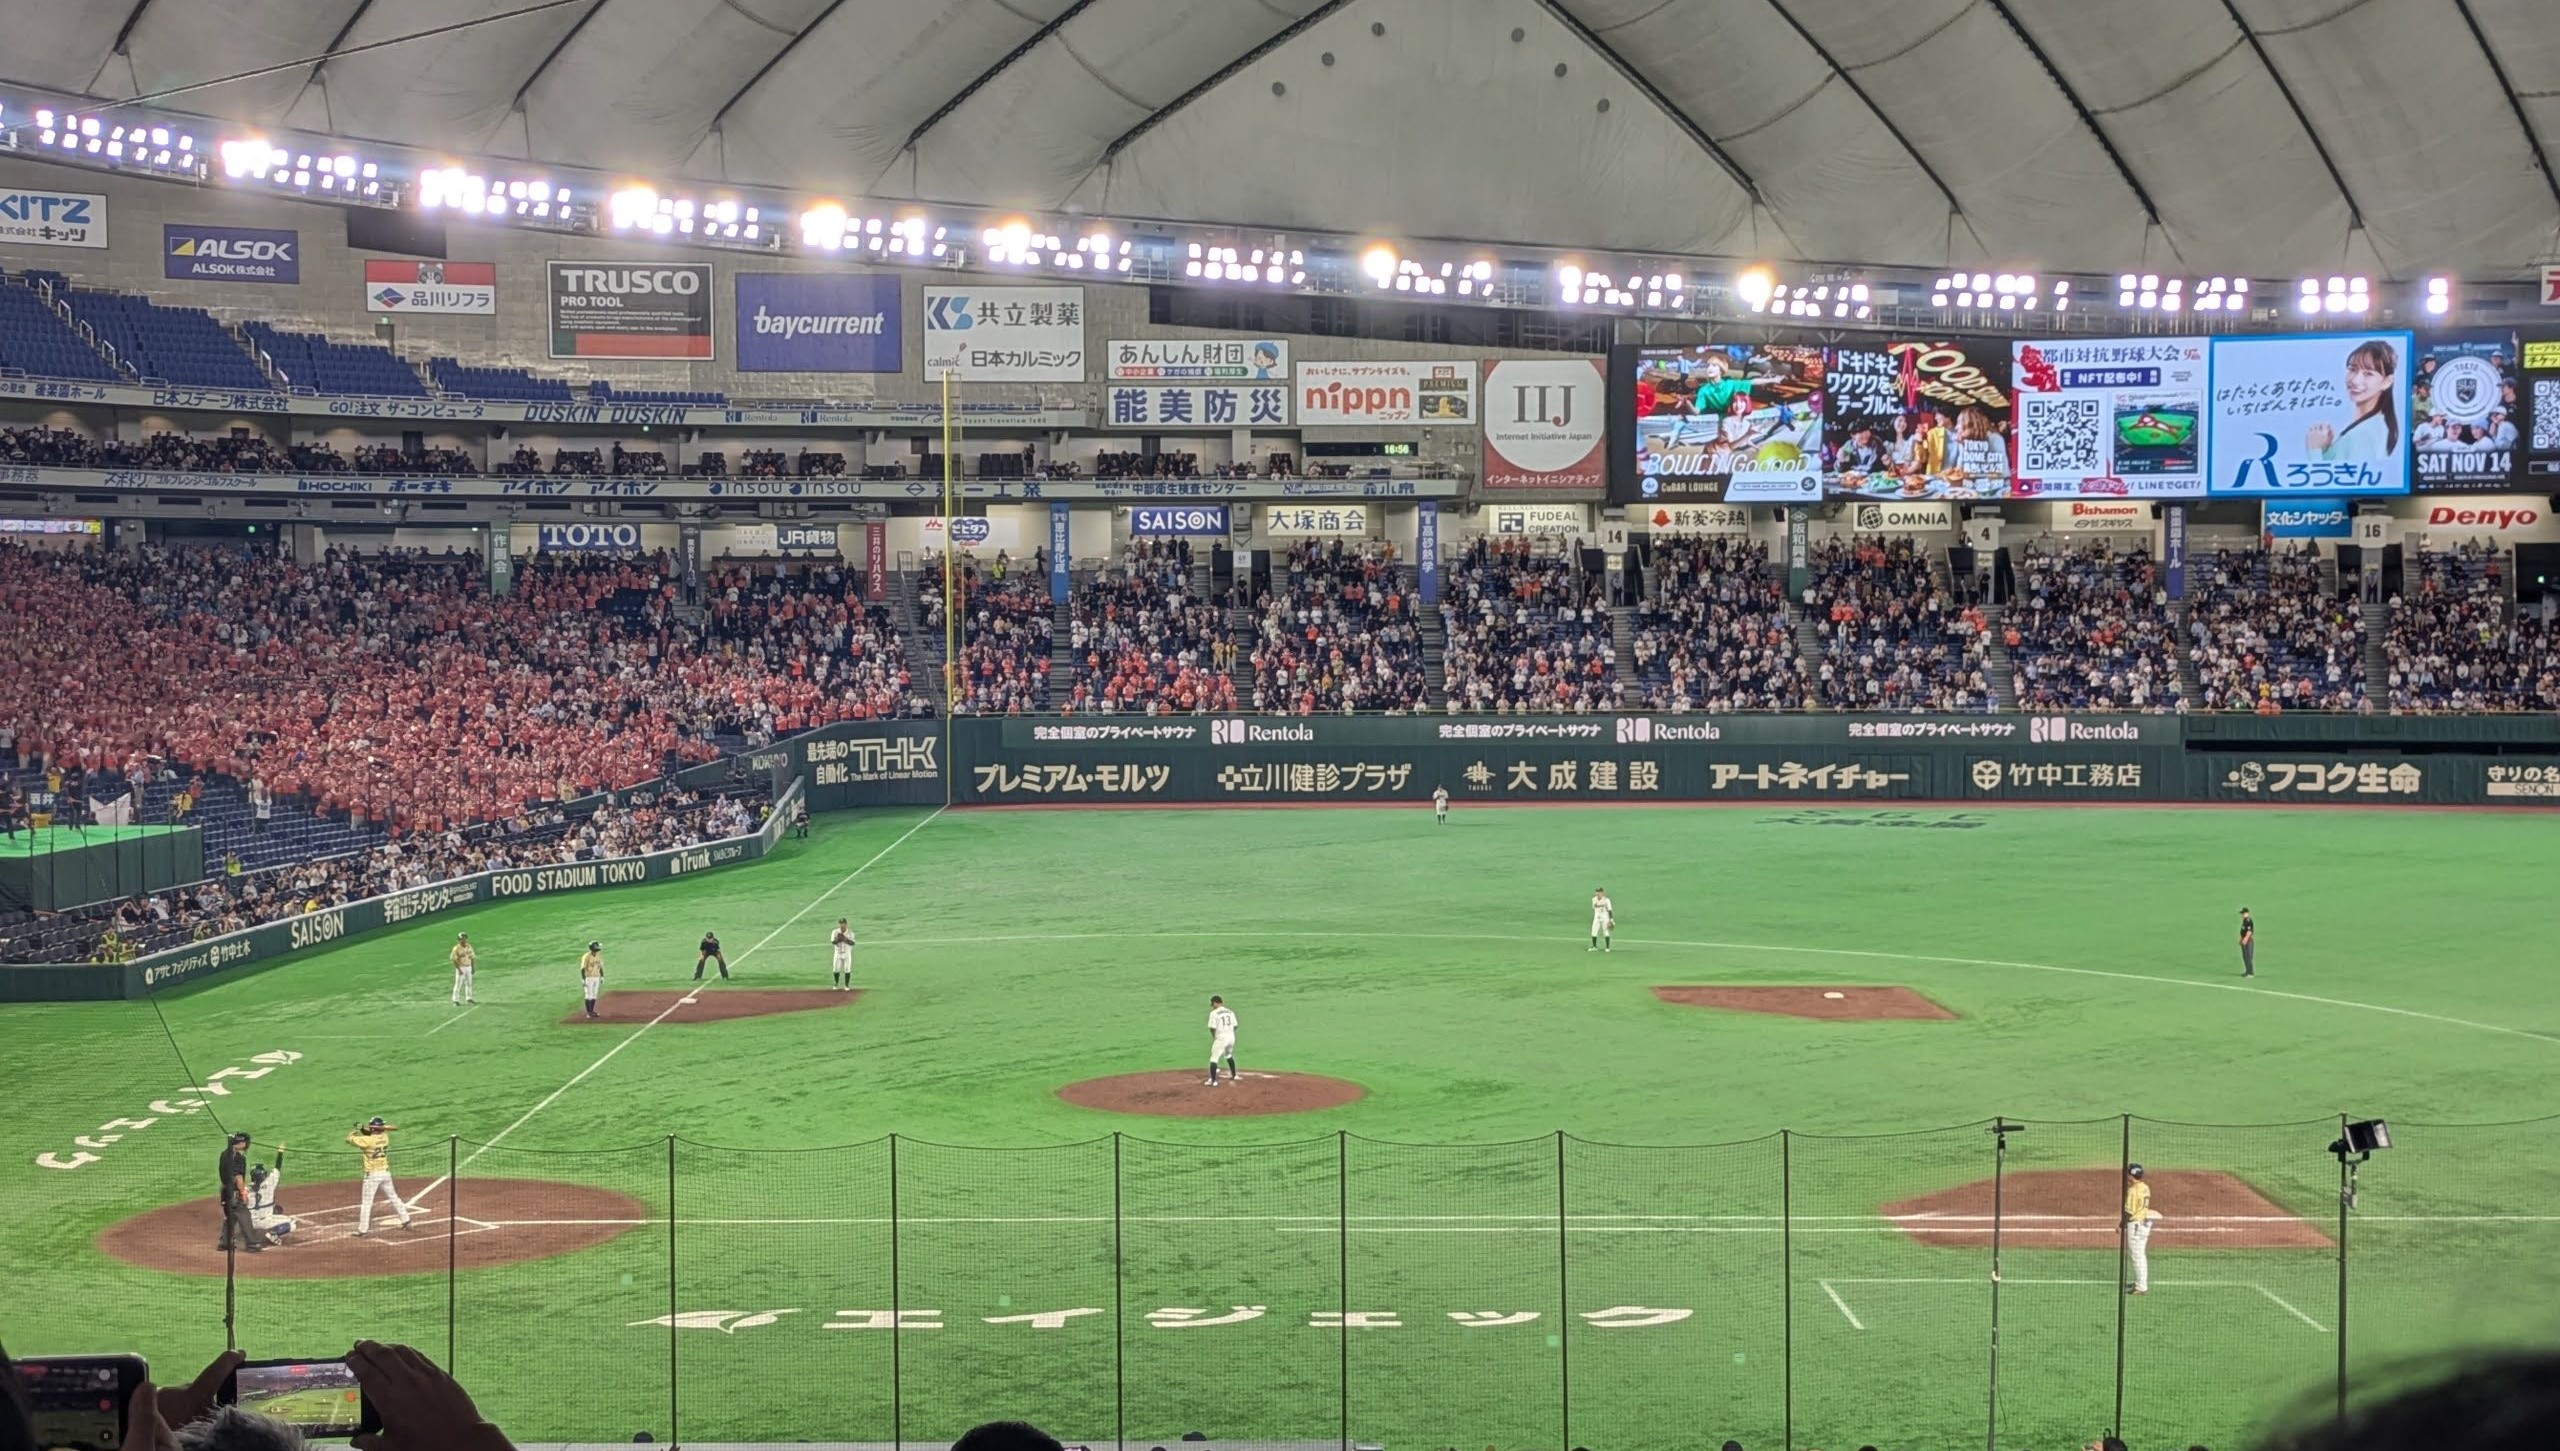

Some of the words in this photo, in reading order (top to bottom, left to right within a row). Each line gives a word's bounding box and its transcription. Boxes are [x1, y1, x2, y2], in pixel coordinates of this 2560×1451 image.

[0, 194, 91, 224] KITZ
[39, 226, 87, 241] キッツ
[195, 238, 293, 261] ALSOK
[560, 269, 699, 295] TRUSCO
[411, 291, 490, 308] 品川リフラ
[560, 295, 587, 307] PRO
[589, 296, 624, 308] TOOL
[754, 305, 885, 340] baycurrent
[976, 301, 1081, 328] 共立製薬
[927, 356, 960, 367] calmic
[971, 350, 1081, 369] 日本カルミック
[1119, 343, 1244, 364] あんしん財団
[1837, 350, 1899, 376] ドキドキと
[2043, 345, 2180, 364] 都市対抗野球大会
[1306, 381, 1411, 415] nippn
[2216, 377, 2335, 402] はたらくあなたの、
[153, 390, 289, 411] 日本ステージ株式会社
[328, 401, 381, 417] GO!注文
[1113, 388, 1284, 424] 能美防災
[1512, 385, 1577, 427] IIJ
[2227, 395, 2343, 416] いちばんそばに。
[743, 412, 778, 423] Rentola
[819, 412, 853, 423] Rentola
[1496, 432, 1529, 440] Internet
[1530, 432, 1567, 440] Initiative
[1568, 432, 1593, 442] Japan
[2417, 452, 2449, 474] SAT
[2451, 452, 2487, 473] NOV
[2490, 451, 2512, 473] 14
[2286, 462, 2382, 487] ろうきん
[308, 481, 373, 492] HOCHIKI
[389, 479, 452, 493] ホーチキ
[502, 479, 573, 494] アイホン
[590, 481, 660, 495] アイホン
[1688, 482, 1719, 493] LOUNGE
[1269, 509, 1365, 531] 大塚商会
[1529, 511, 1579, 521] FUDEAL
[1888, 511, 1948, 526] OMNIA
[2071, 502, 2138, 517] Bishamon
[2266, 511, 2350, 526] 文化シヤッター
[2428, 507, 2538, 529] Denyo
[1138, 511, 1222, 530] SAISON
[1528, 524, 1580, 534] CREATION
[2365, 523, 2381, 538] 16
[542, 523, 637, 546] TOTO
[779, 529, 836, 545] JR貨物
[1607, 530, 1622, 543] 14
[1980, 527, 1991, 541] 4
[872, 526, 882, 592] 三井のリハウス
[1033, 725, 1196, 741] 完全個室のプライベートサウナ
[1249, 723, 1314, 741] Rentola
[1438, 724, 1602, 739] 完全個室のプライベートサウナ
[1654, 721, 1720, 741] Rentola
[1848, 722, 2016, 738] 完全個室のプライベートサウナ
[2070, 721, 2139, 741] Rentola
[807, 740, 848, 763] 最先端の
[850, 736, 937, 771] THK
[850, 772, 862, 782] The
[863, 771, 879, 781] Mark
[879, 770, 888, 780] of
[888, 770, 911, 780] Linear
[911, 769, 939, 779] Motion
[973, 763, 1171, 793] プレミアム・モルツ
[1240, 762, 1412, 792] 立川健診プラザ
[1507, 760, 1660, 791] 大成建設
[1709, 760, 1910, 790] アートネイチャー
[2008, 762, 2142, 788] 竹中工務店
[2266, 762, 2421, 793] フコク生命
[2487, 765, 2560, 782] 守りの名
[680, 848, 711, 872] Trunk
[492, 873, 533, 897] FOOD
[537, 866, 597, 892] STADIUM
[601, 860, 646, 884] TOKYO
[291, 911, 344, 950] SAISON
[220, 939, 251, 963] 竹中土木
[1221, 1015, 1232, 1026] 13
